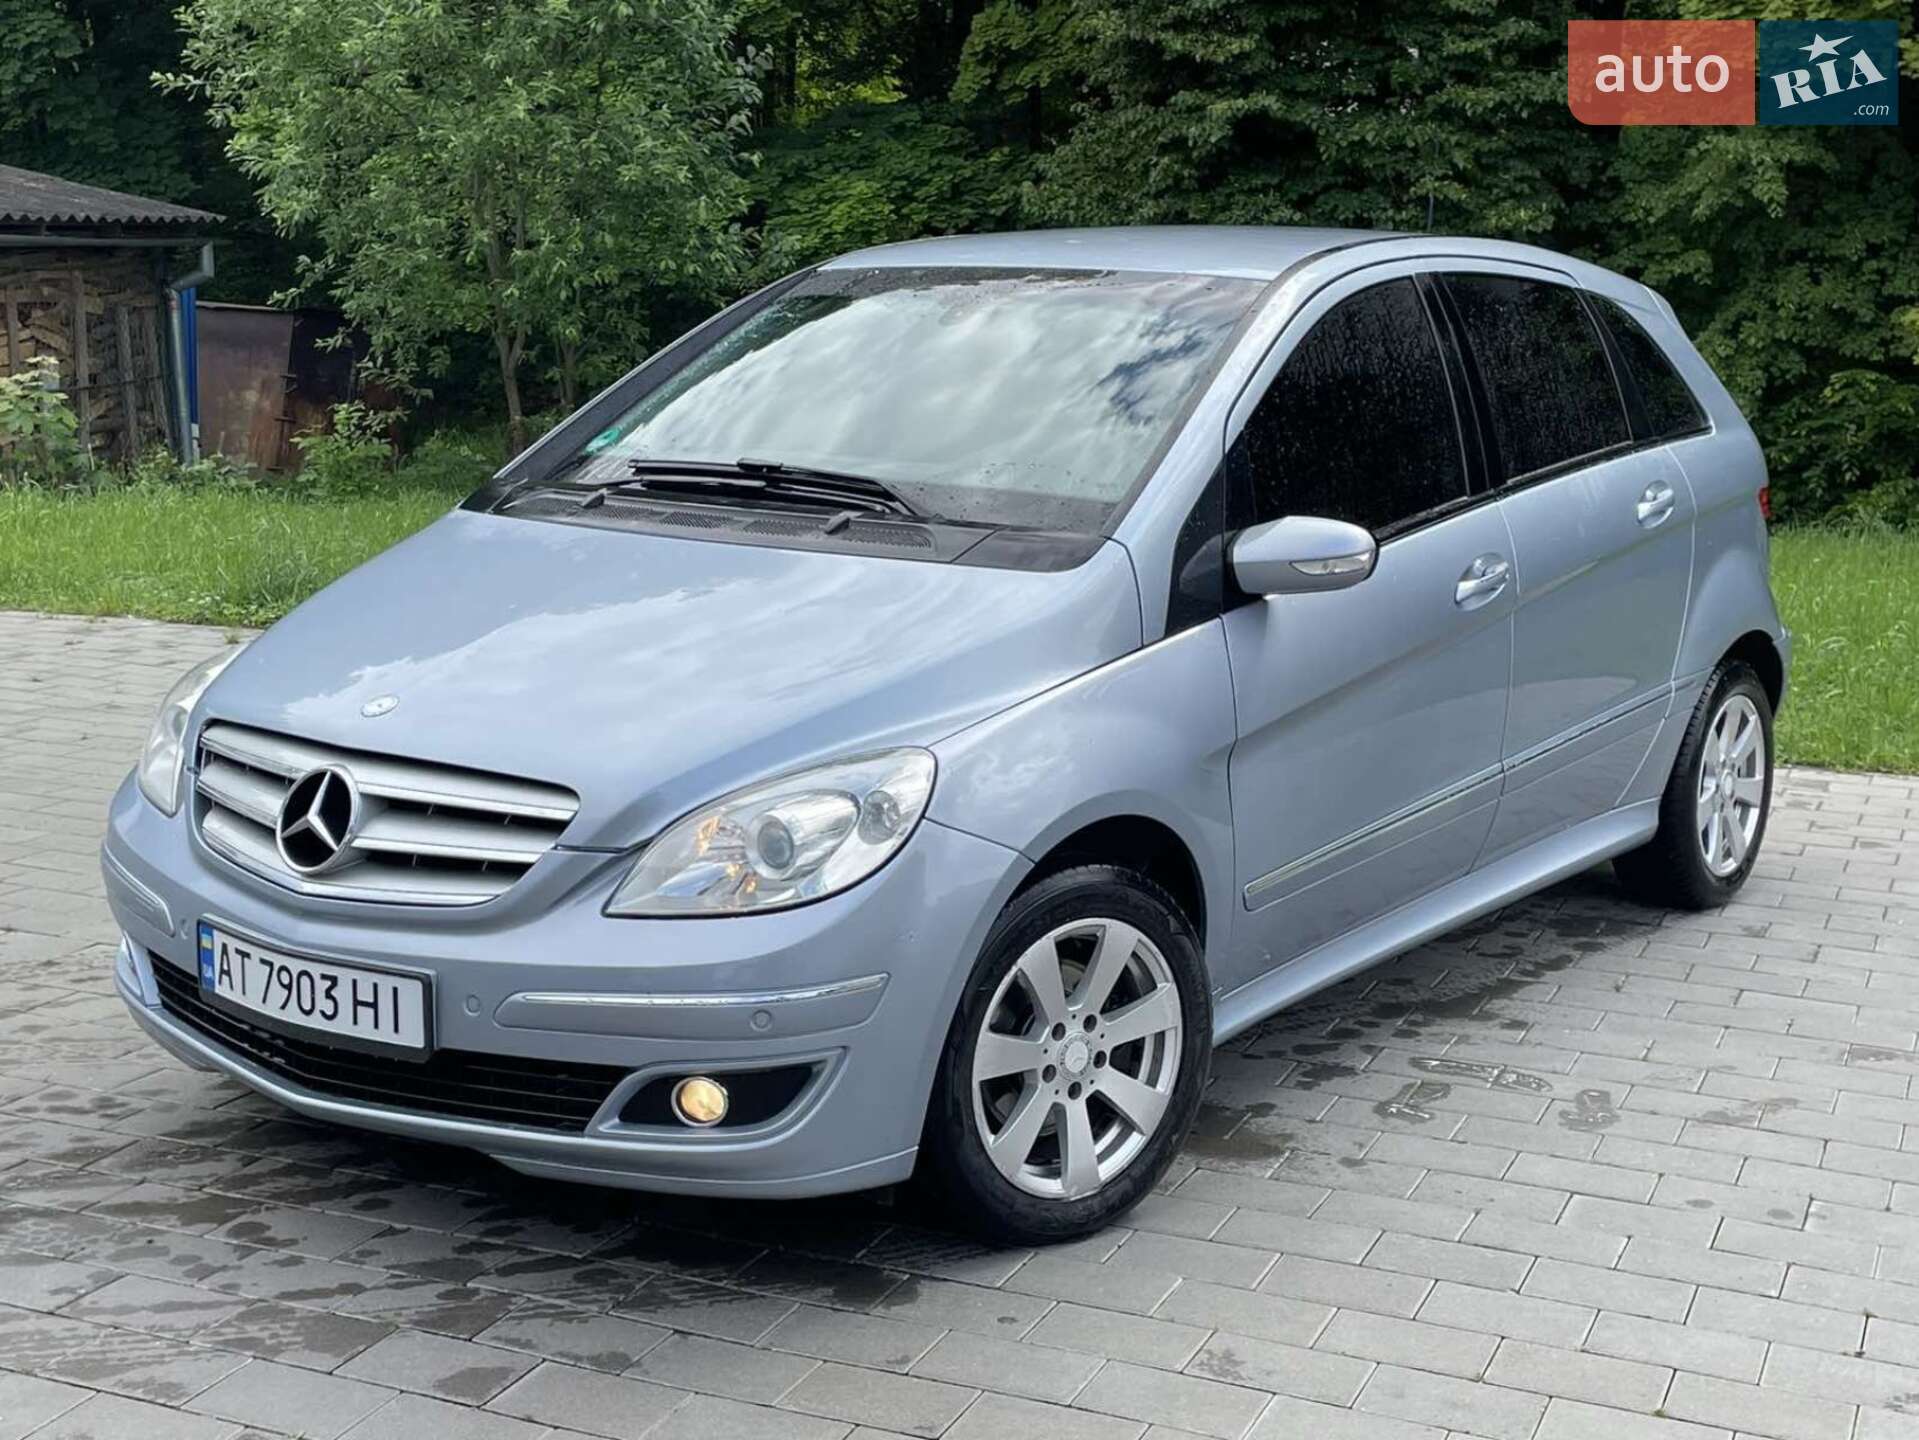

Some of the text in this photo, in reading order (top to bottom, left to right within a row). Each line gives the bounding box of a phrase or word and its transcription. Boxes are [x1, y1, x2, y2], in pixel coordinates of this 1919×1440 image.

[218, 942, 399, 1034] AT 7903 HI
